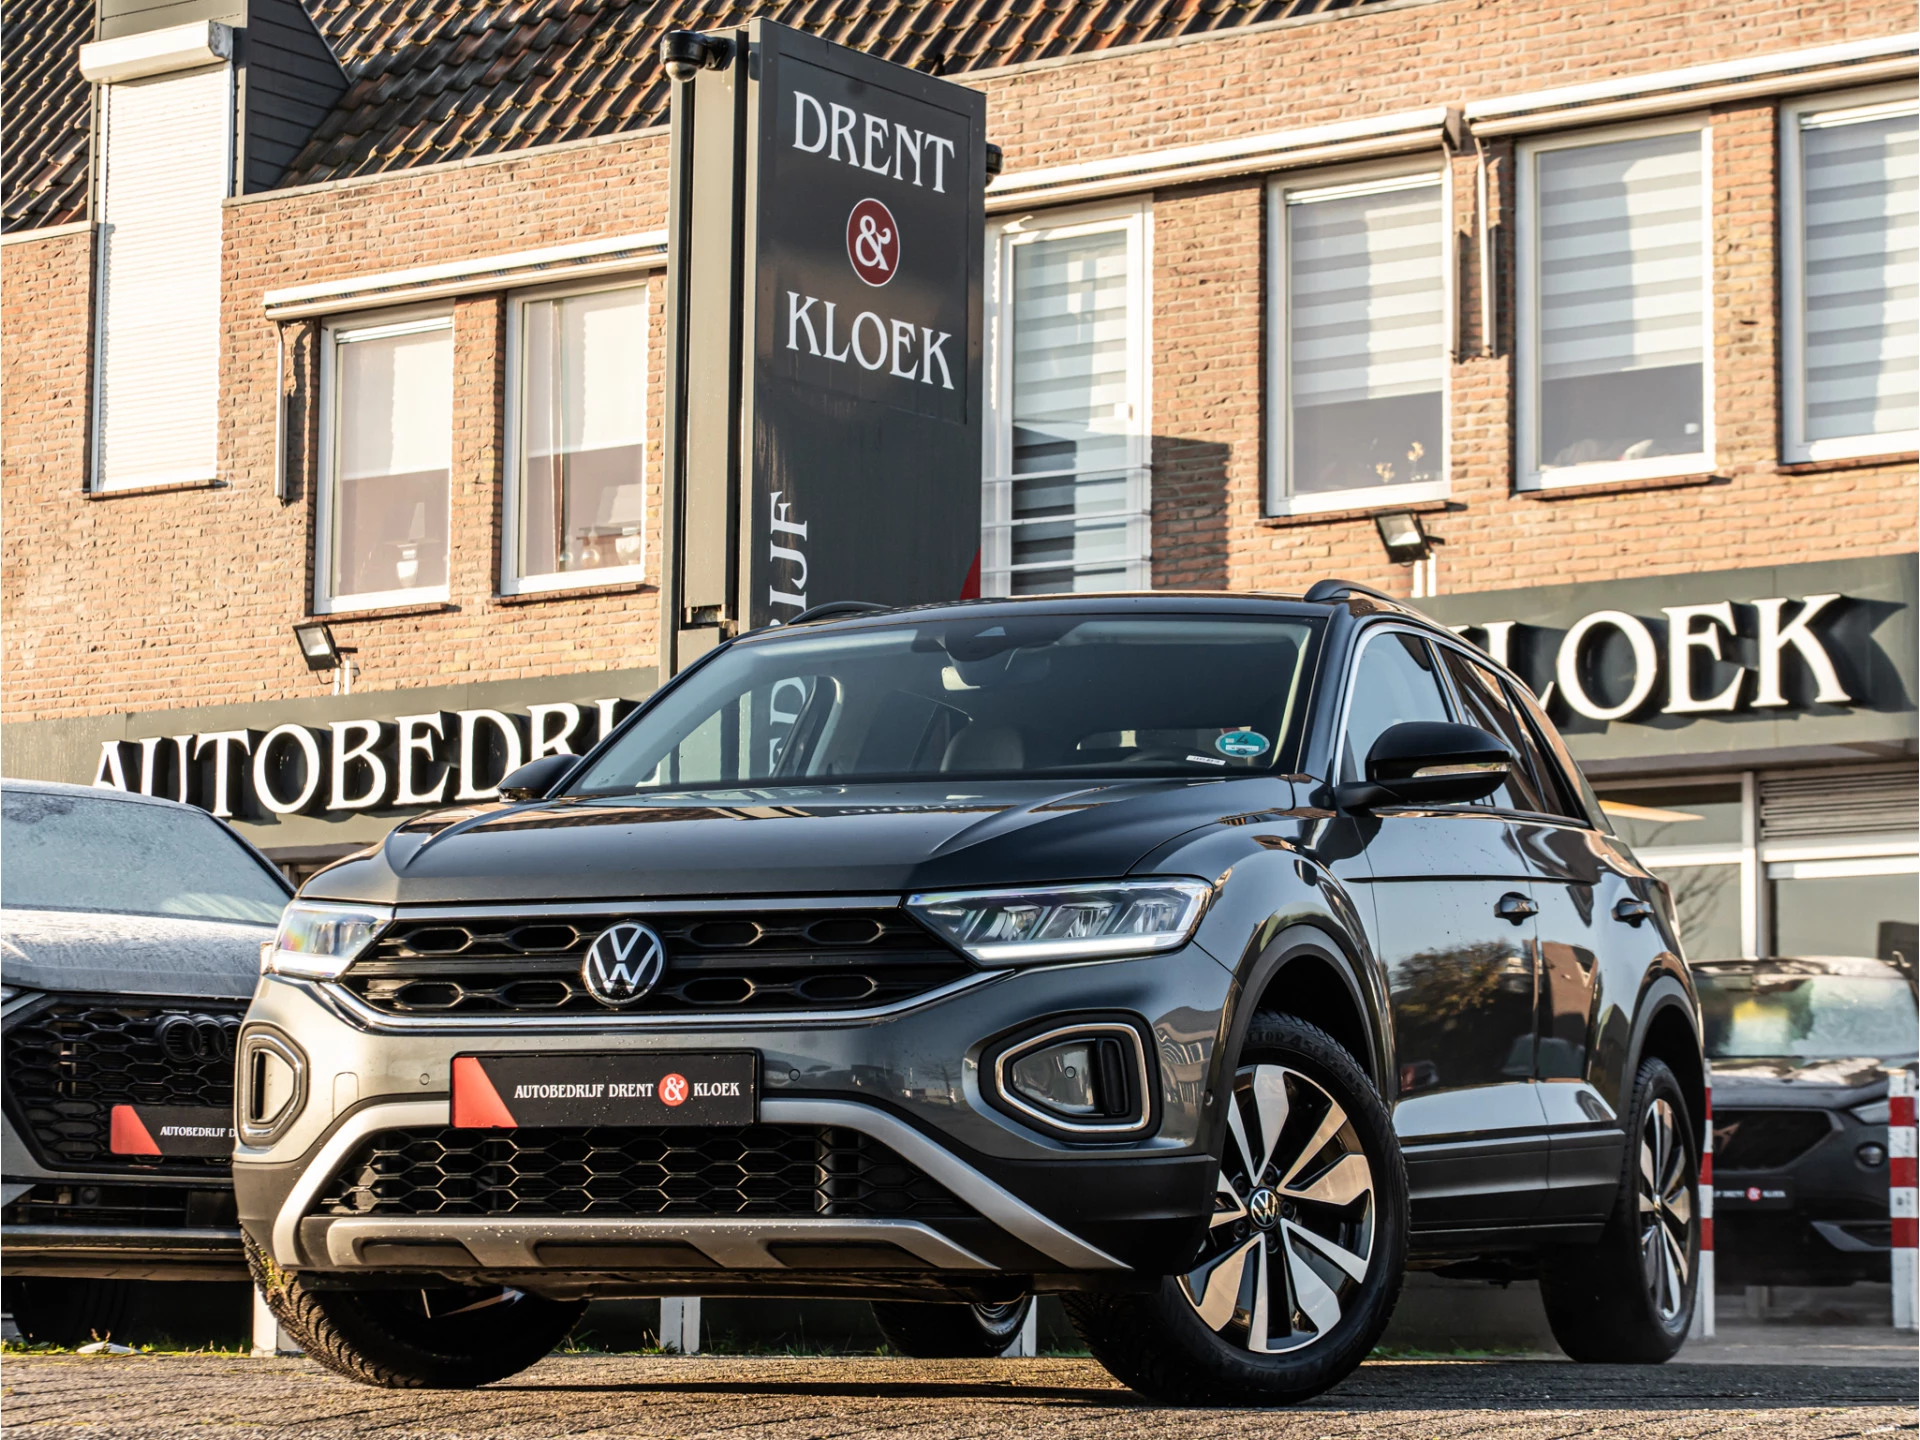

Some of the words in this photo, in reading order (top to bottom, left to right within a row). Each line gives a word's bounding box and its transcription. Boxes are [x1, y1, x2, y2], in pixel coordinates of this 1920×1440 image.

[792, 91, 955, 194] DRENT
[855, 215, 891, 271] &
[786, 290, 955, 390] KLOEK
[1449, 593, 1852, 721] LOEK
[92, 697, 660, 818] AUTOBEDRI
[160, 1126, 226, 1138] AUTOBEDRIJF
[514, 1084, 605, 1098] AUTOBEDRIJF
[609, 1083, 654, 1098] DRENT
[664, 1077, 685, 1101] &
[693, 1082, 740, 1097] KLOEK
